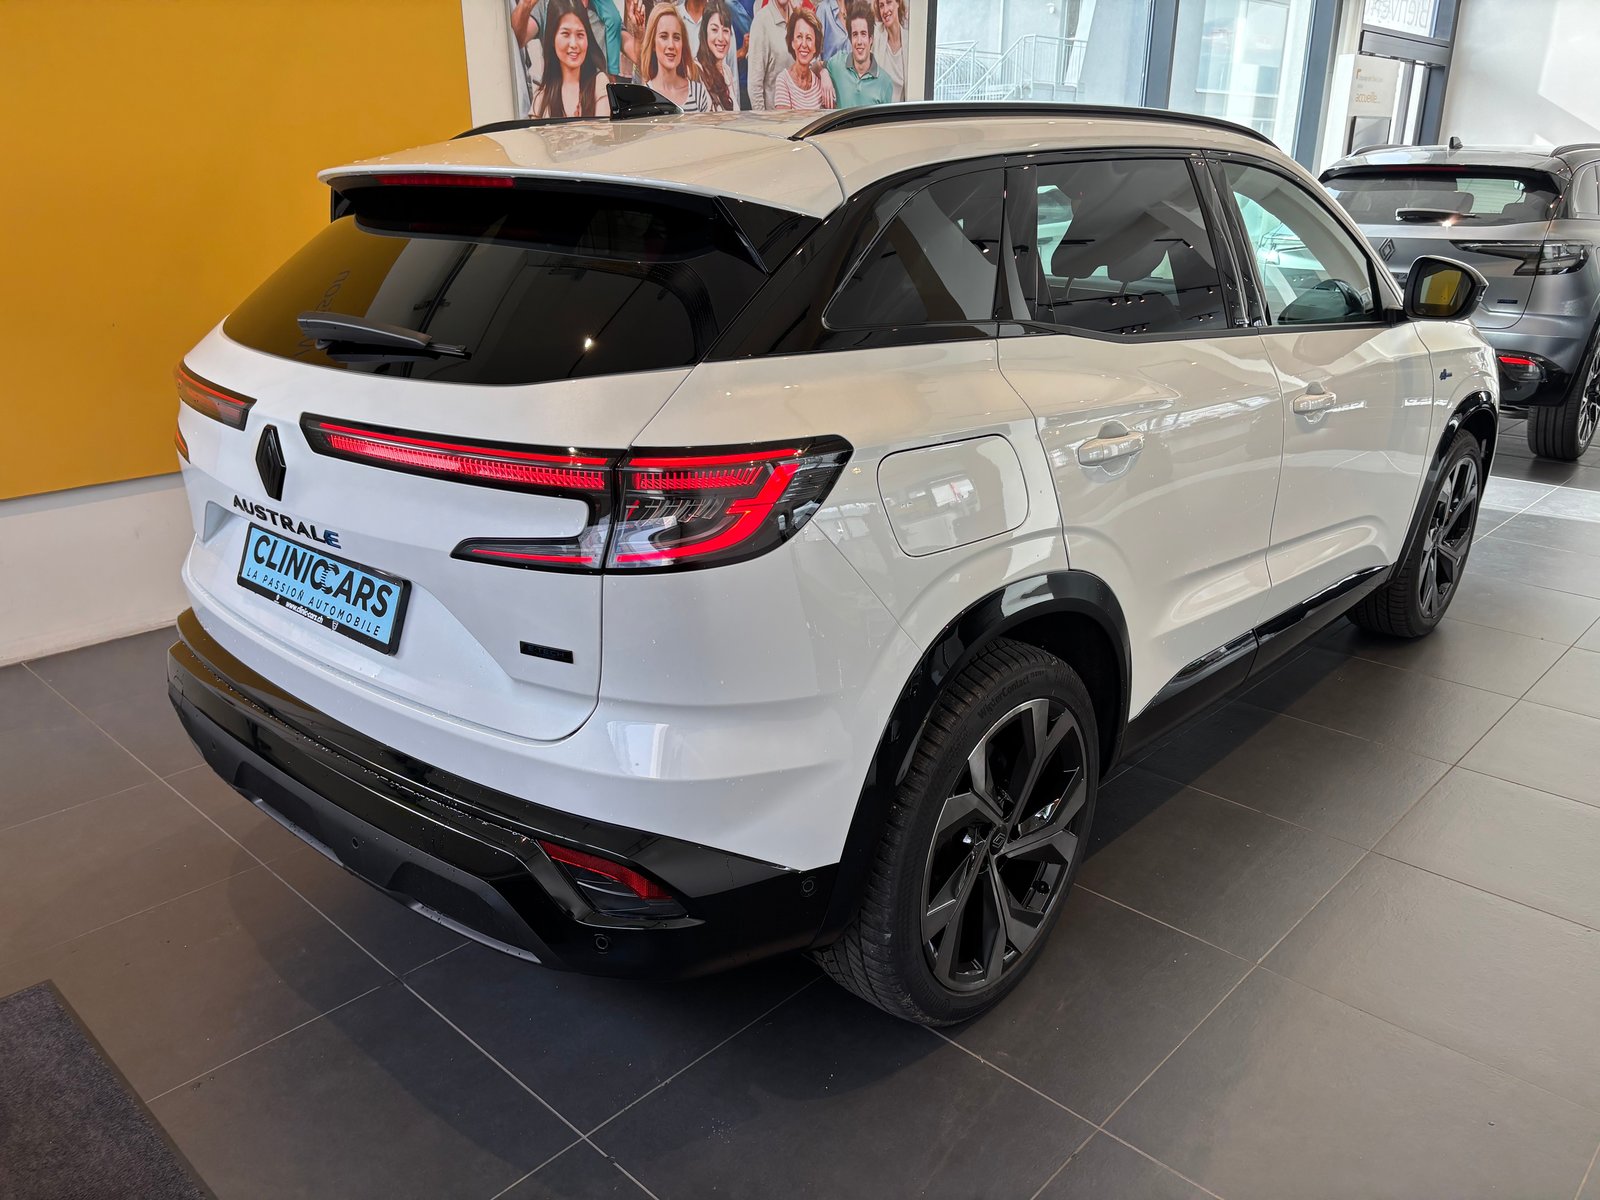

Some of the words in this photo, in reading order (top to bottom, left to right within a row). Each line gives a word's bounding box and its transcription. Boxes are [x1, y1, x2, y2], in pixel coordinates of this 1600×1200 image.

[246, 567, 257, 579] LA
[262, 575, 305, 601] PASSION
[308, 596, 381, 636] AUTOMOBILE
